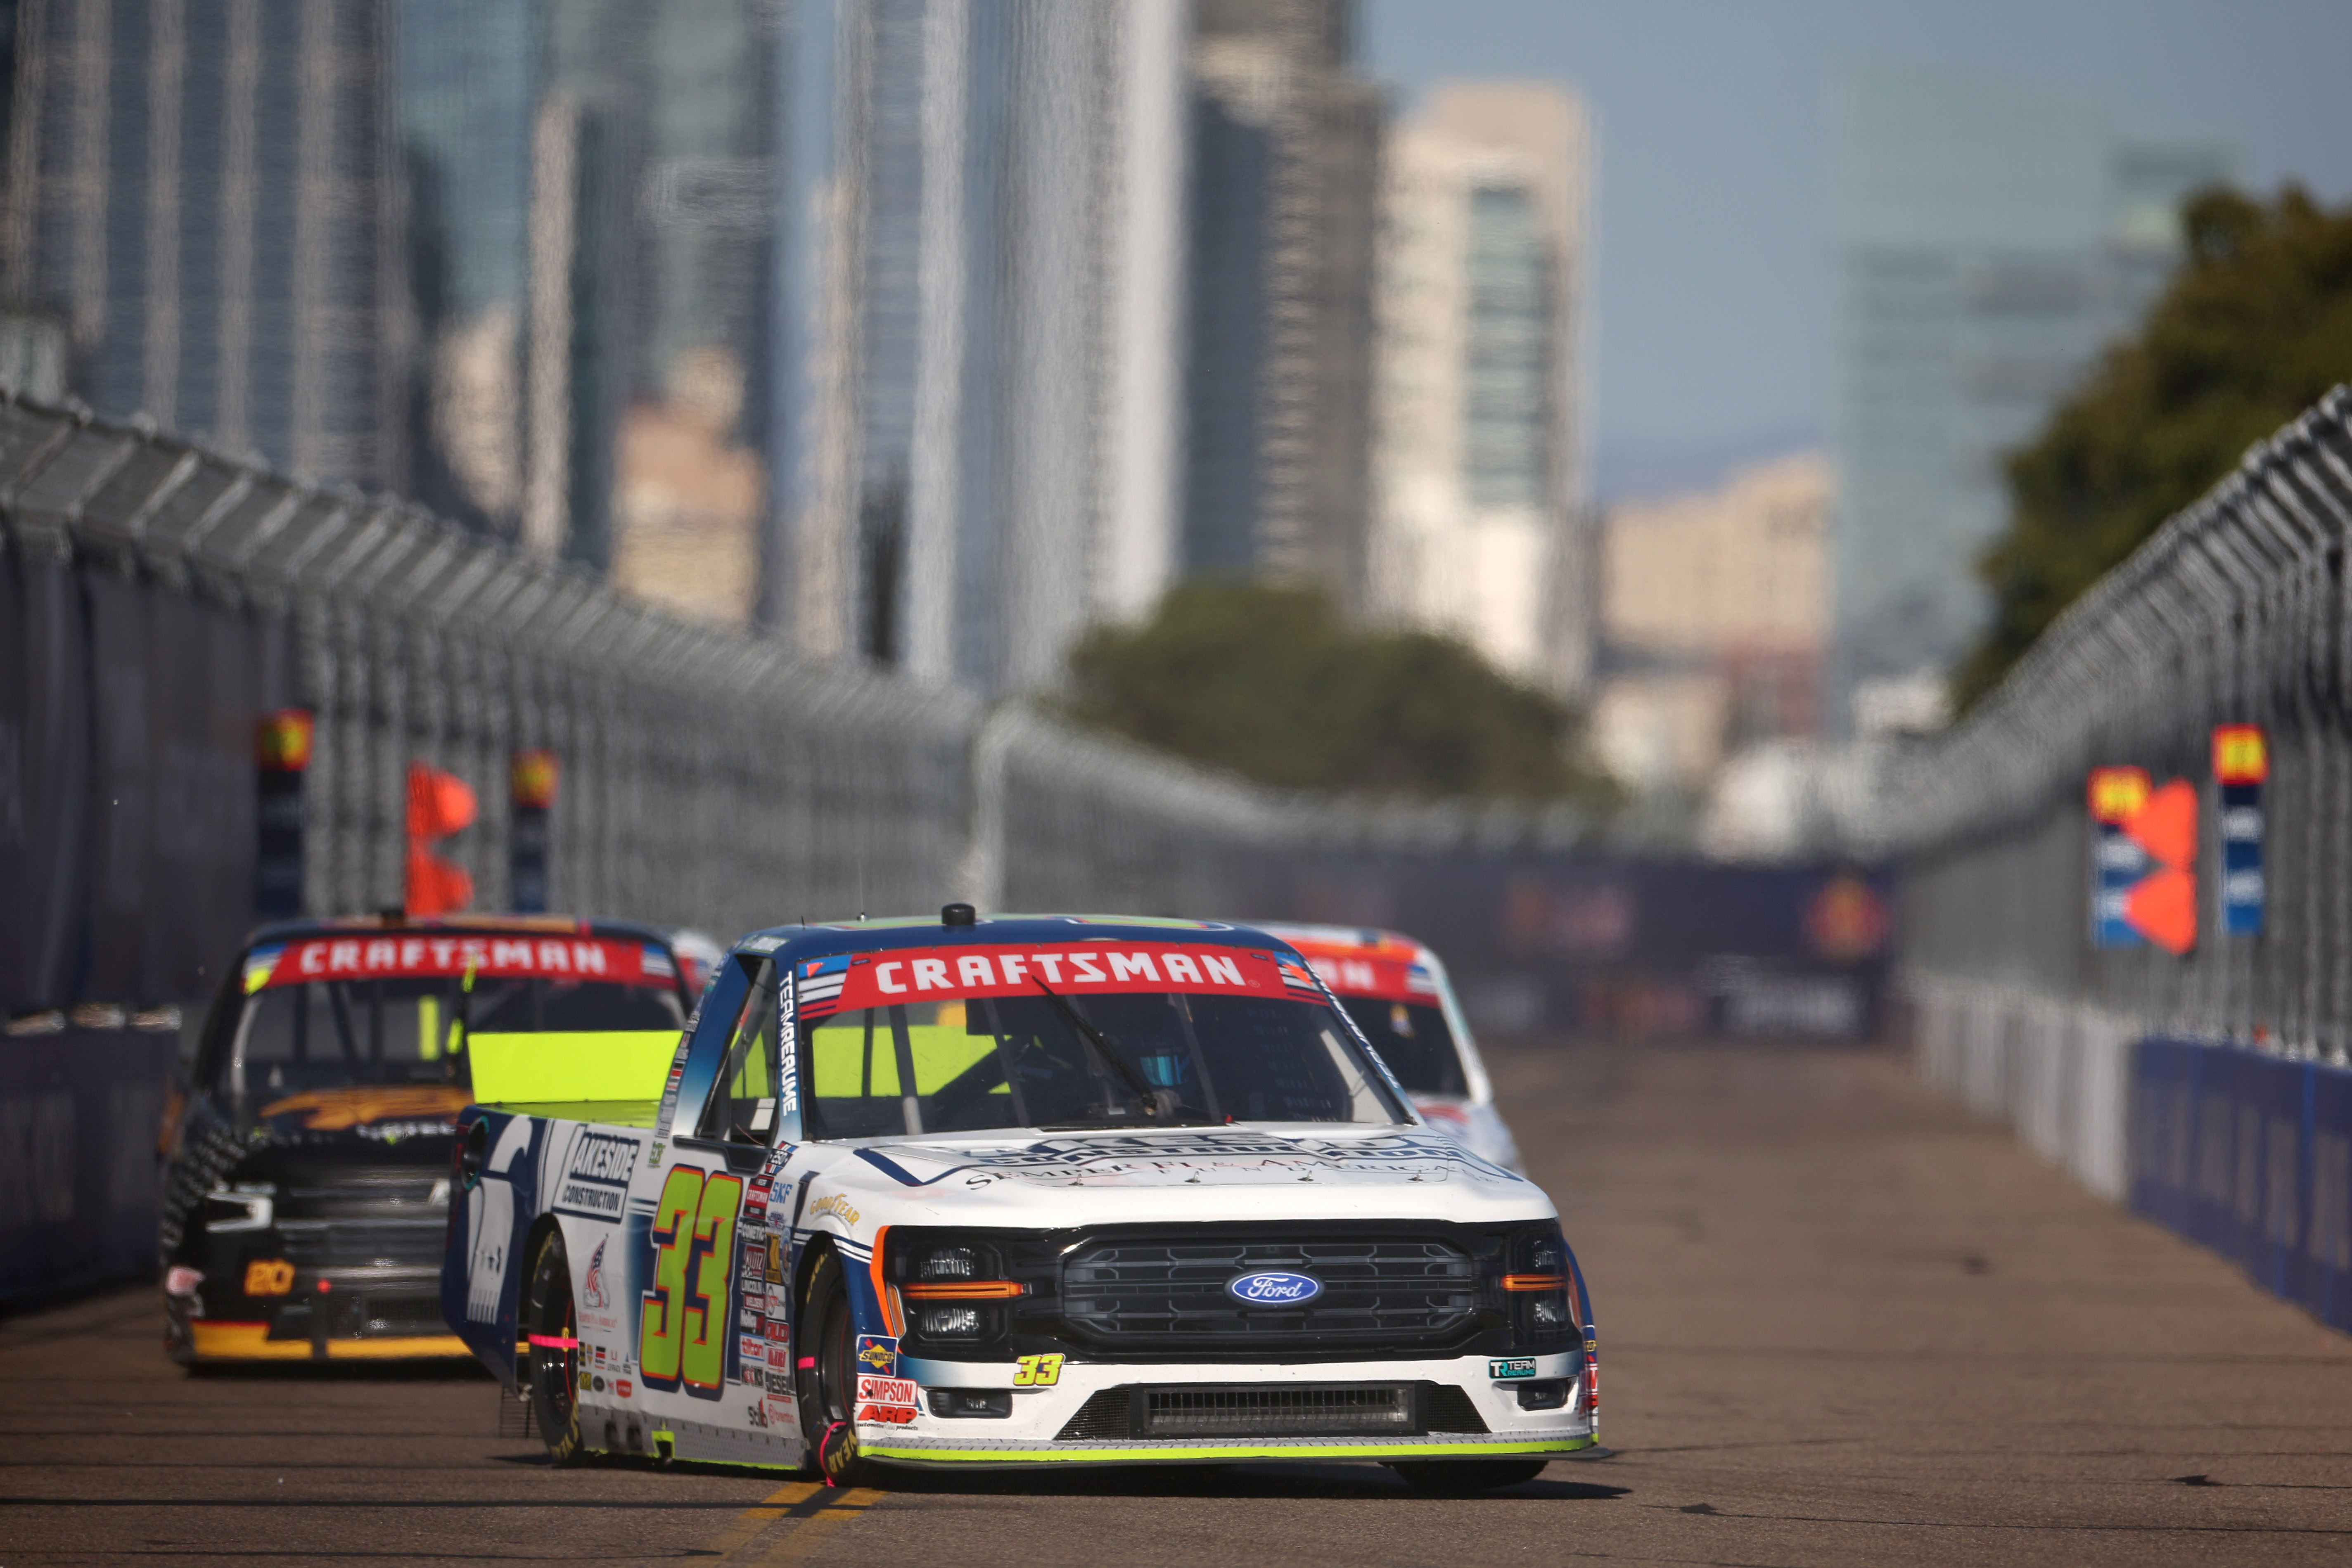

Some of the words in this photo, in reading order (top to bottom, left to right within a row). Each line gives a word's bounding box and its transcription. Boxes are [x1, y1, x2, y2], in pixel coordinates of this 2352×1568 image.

[299, 936, 607, 975] CRAFTSMAN
[875, 953, 1246, 994] CRAFTSMAN
[564, 1124, 640, 1182] LAKESIDE
[965, 1163, 1139, 1190] SEMPER
[562, 1184, 621, 1211] CONSTRUCTION
[769, 1182, 793, 1204] SKF
[810, 1193, 860, 1226] GOODYEAR
[244, 1258, 296, 1296] 20
[638, 1164, 743, 1401] 33
[1247, 1277, 1303, 1297] Ford
[862, 1351, 893, 1362] SUNOCO
[1013, 1354, 1066, 1386] 33
[1507, 1360, 1535, 1370] TEAM
[858, 1379, 913, 1402] SIMPSON
[857, 1405, 918, 1424] ARP
